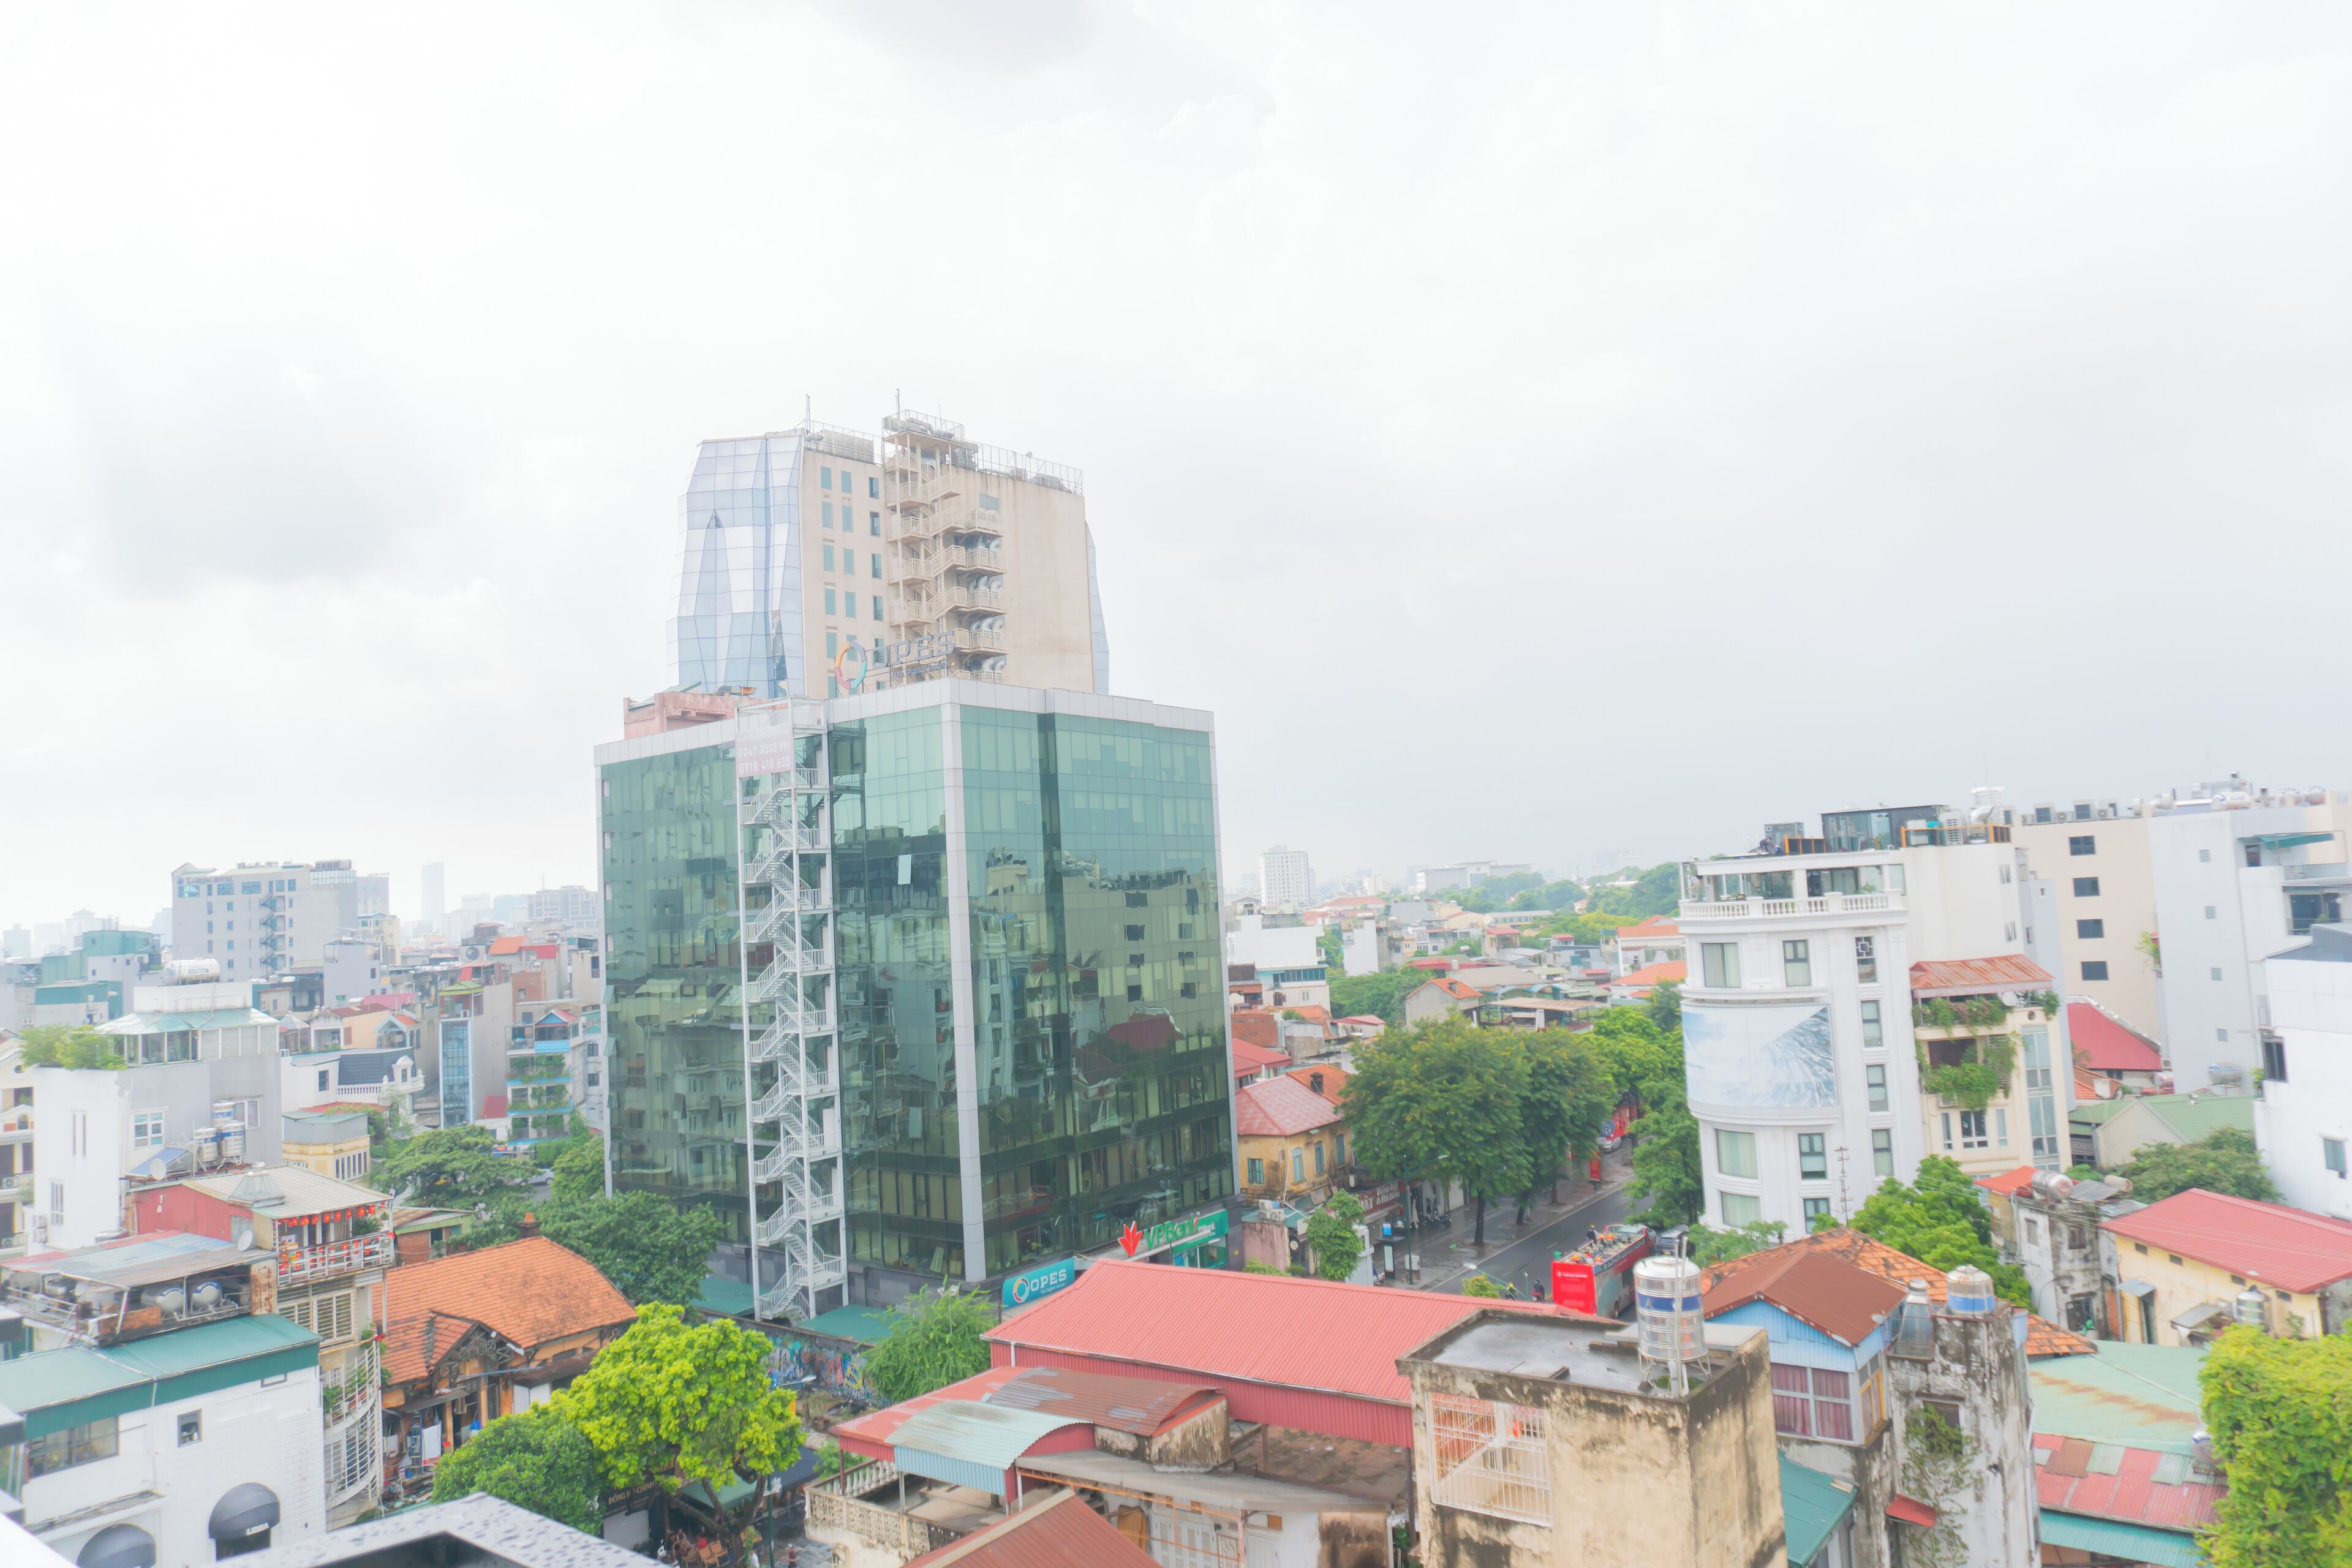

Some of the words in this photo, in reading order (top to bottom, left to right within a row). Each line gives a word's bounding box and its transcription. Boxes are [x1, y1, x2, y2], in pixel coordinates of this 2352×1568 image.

[872, 631, 955, 668] OPES
[906, 665, 927, 676] Digital
[739, 745, 756, 758] 0247
[760, 742, 777, 754] 3033
[779, 741, 790, 751] 991
[739, 761, 758, 774] 0918
[761, 759, 774, 769] 418
[777, 756, 790, 768] 635
[1144, 1213, 1199, 1250] VPBank
[1031, 1268, 1066, 1291] OPES
